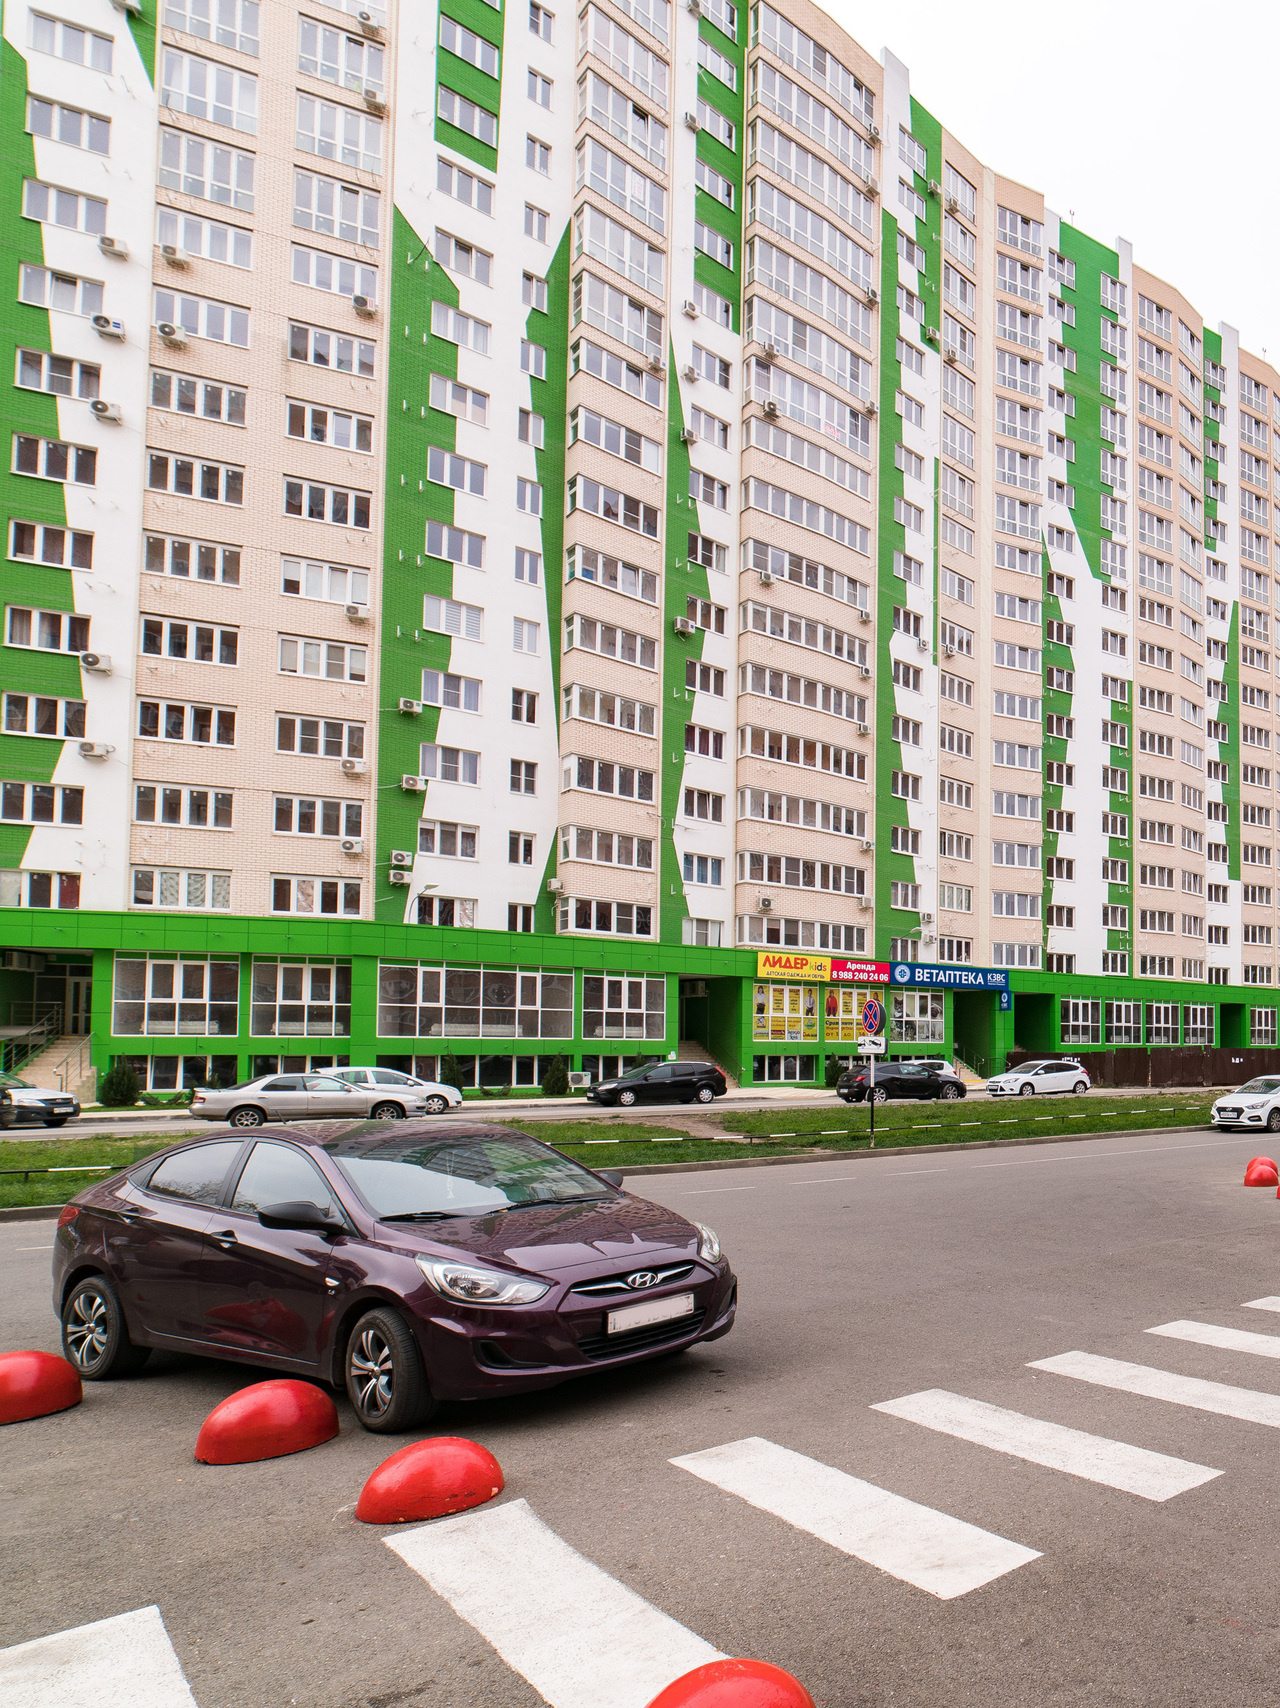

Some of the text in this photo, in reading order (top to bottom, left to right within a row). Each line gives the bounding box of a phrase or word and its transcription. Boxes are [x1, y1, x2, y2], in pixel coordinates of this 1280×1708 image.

[762, 955, 827, 972] ЛИДЕР kids
[846, 961, 876, 971] Аренда
[832, 970, 889, 982] 8 988 240 24 06
[915, 968, 985, 985] ВЕТАПТЕКА
